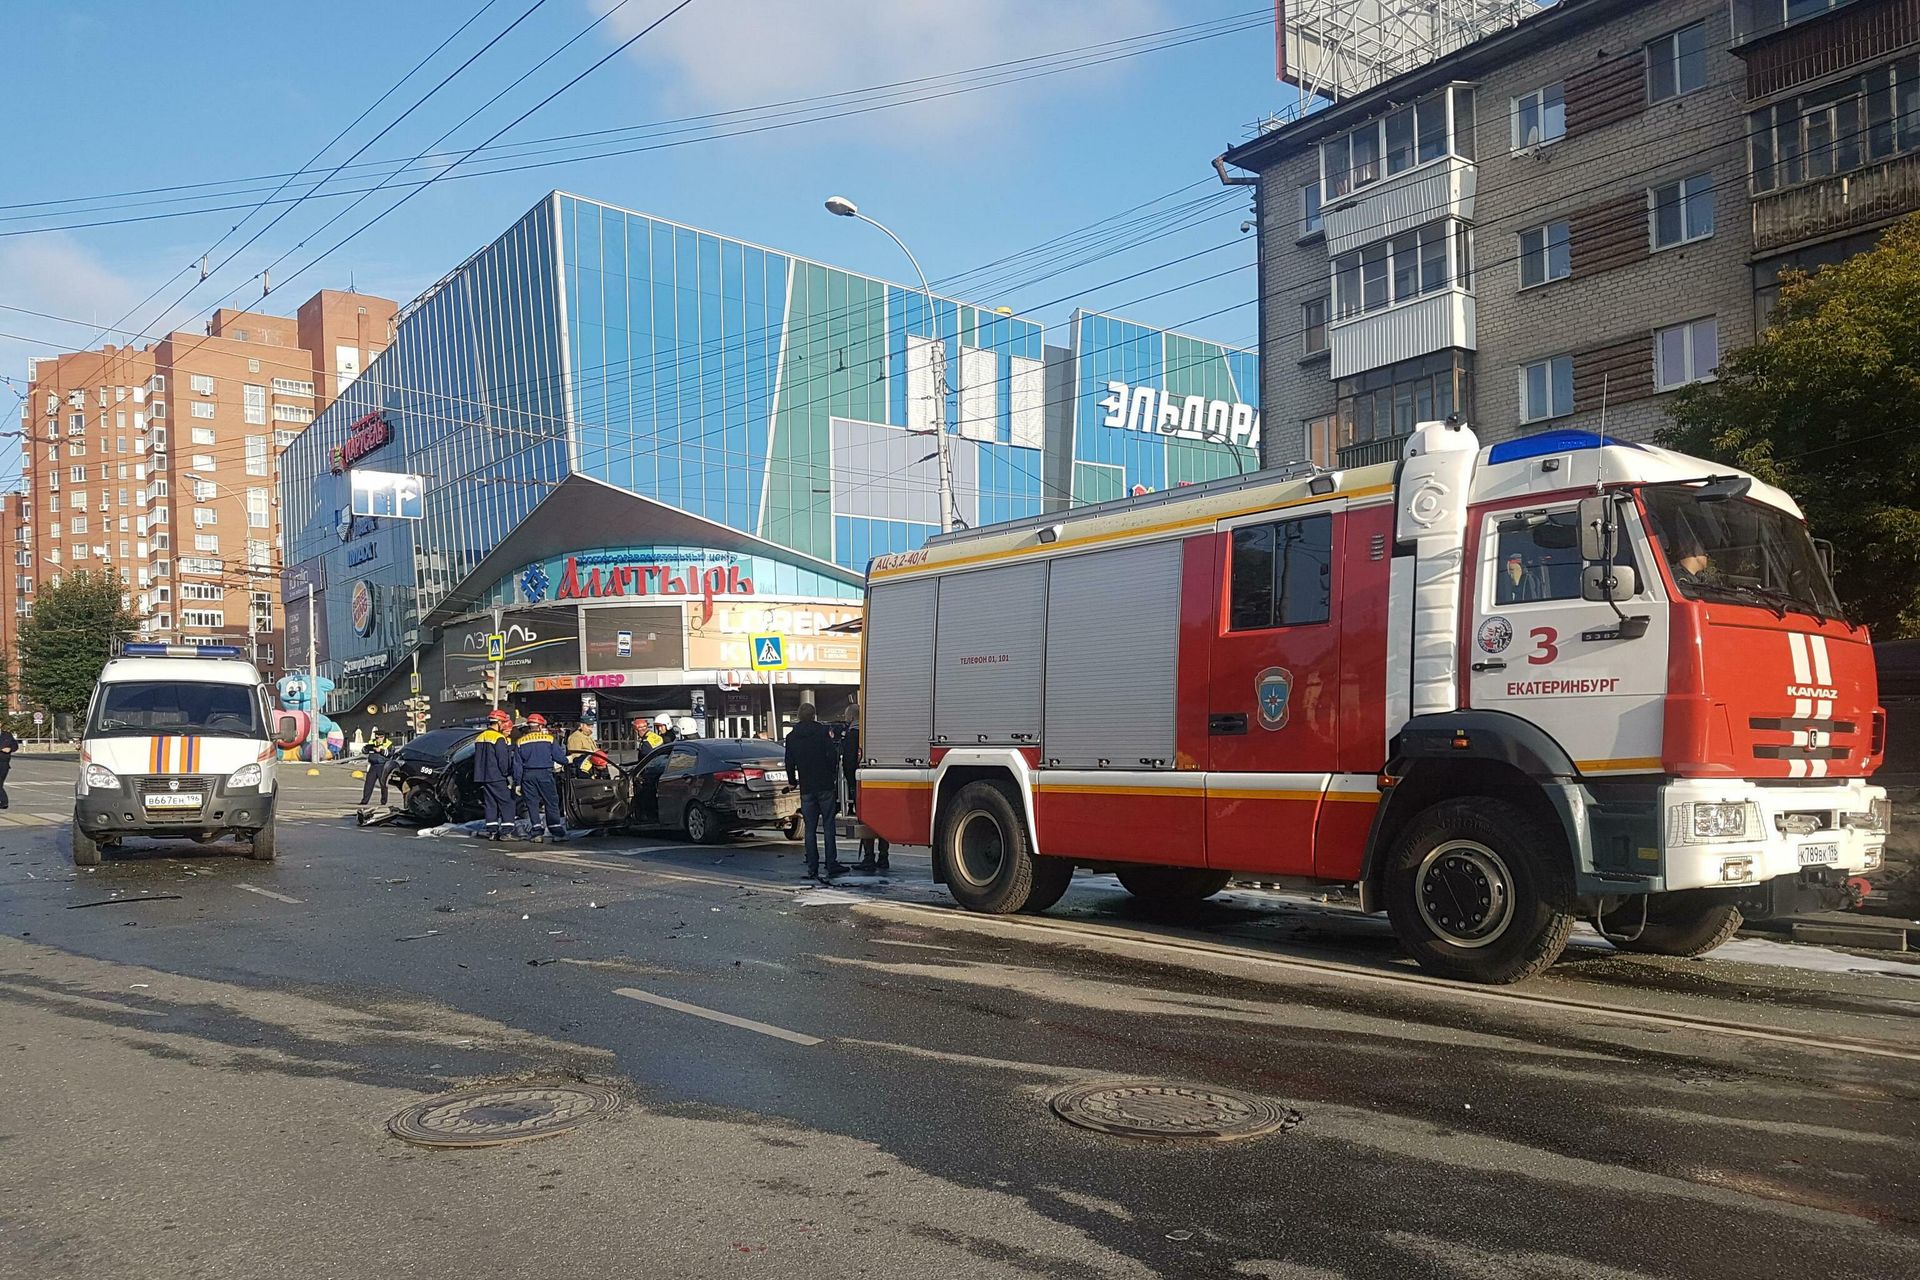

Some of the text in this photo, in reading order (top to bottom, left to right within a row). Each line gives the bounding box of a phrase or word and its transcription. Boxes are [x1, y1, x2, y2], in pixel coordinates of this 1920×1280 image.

[875, 550, 928, 571] АЦ-3,2-40/4
[1527, 626, 1558, 665] 3
[960, 656, 987, 665] ТЕЛЕФОН
[998, 654, 1009, 662] 101
[534, 676, 573, 690] DNS
[1507, 678, 1620, 696] ЕКАТЕРИНБУРГ
[1787, 685, 1838, 699] KAMAZ
[420, 766, 433, 775] 599
